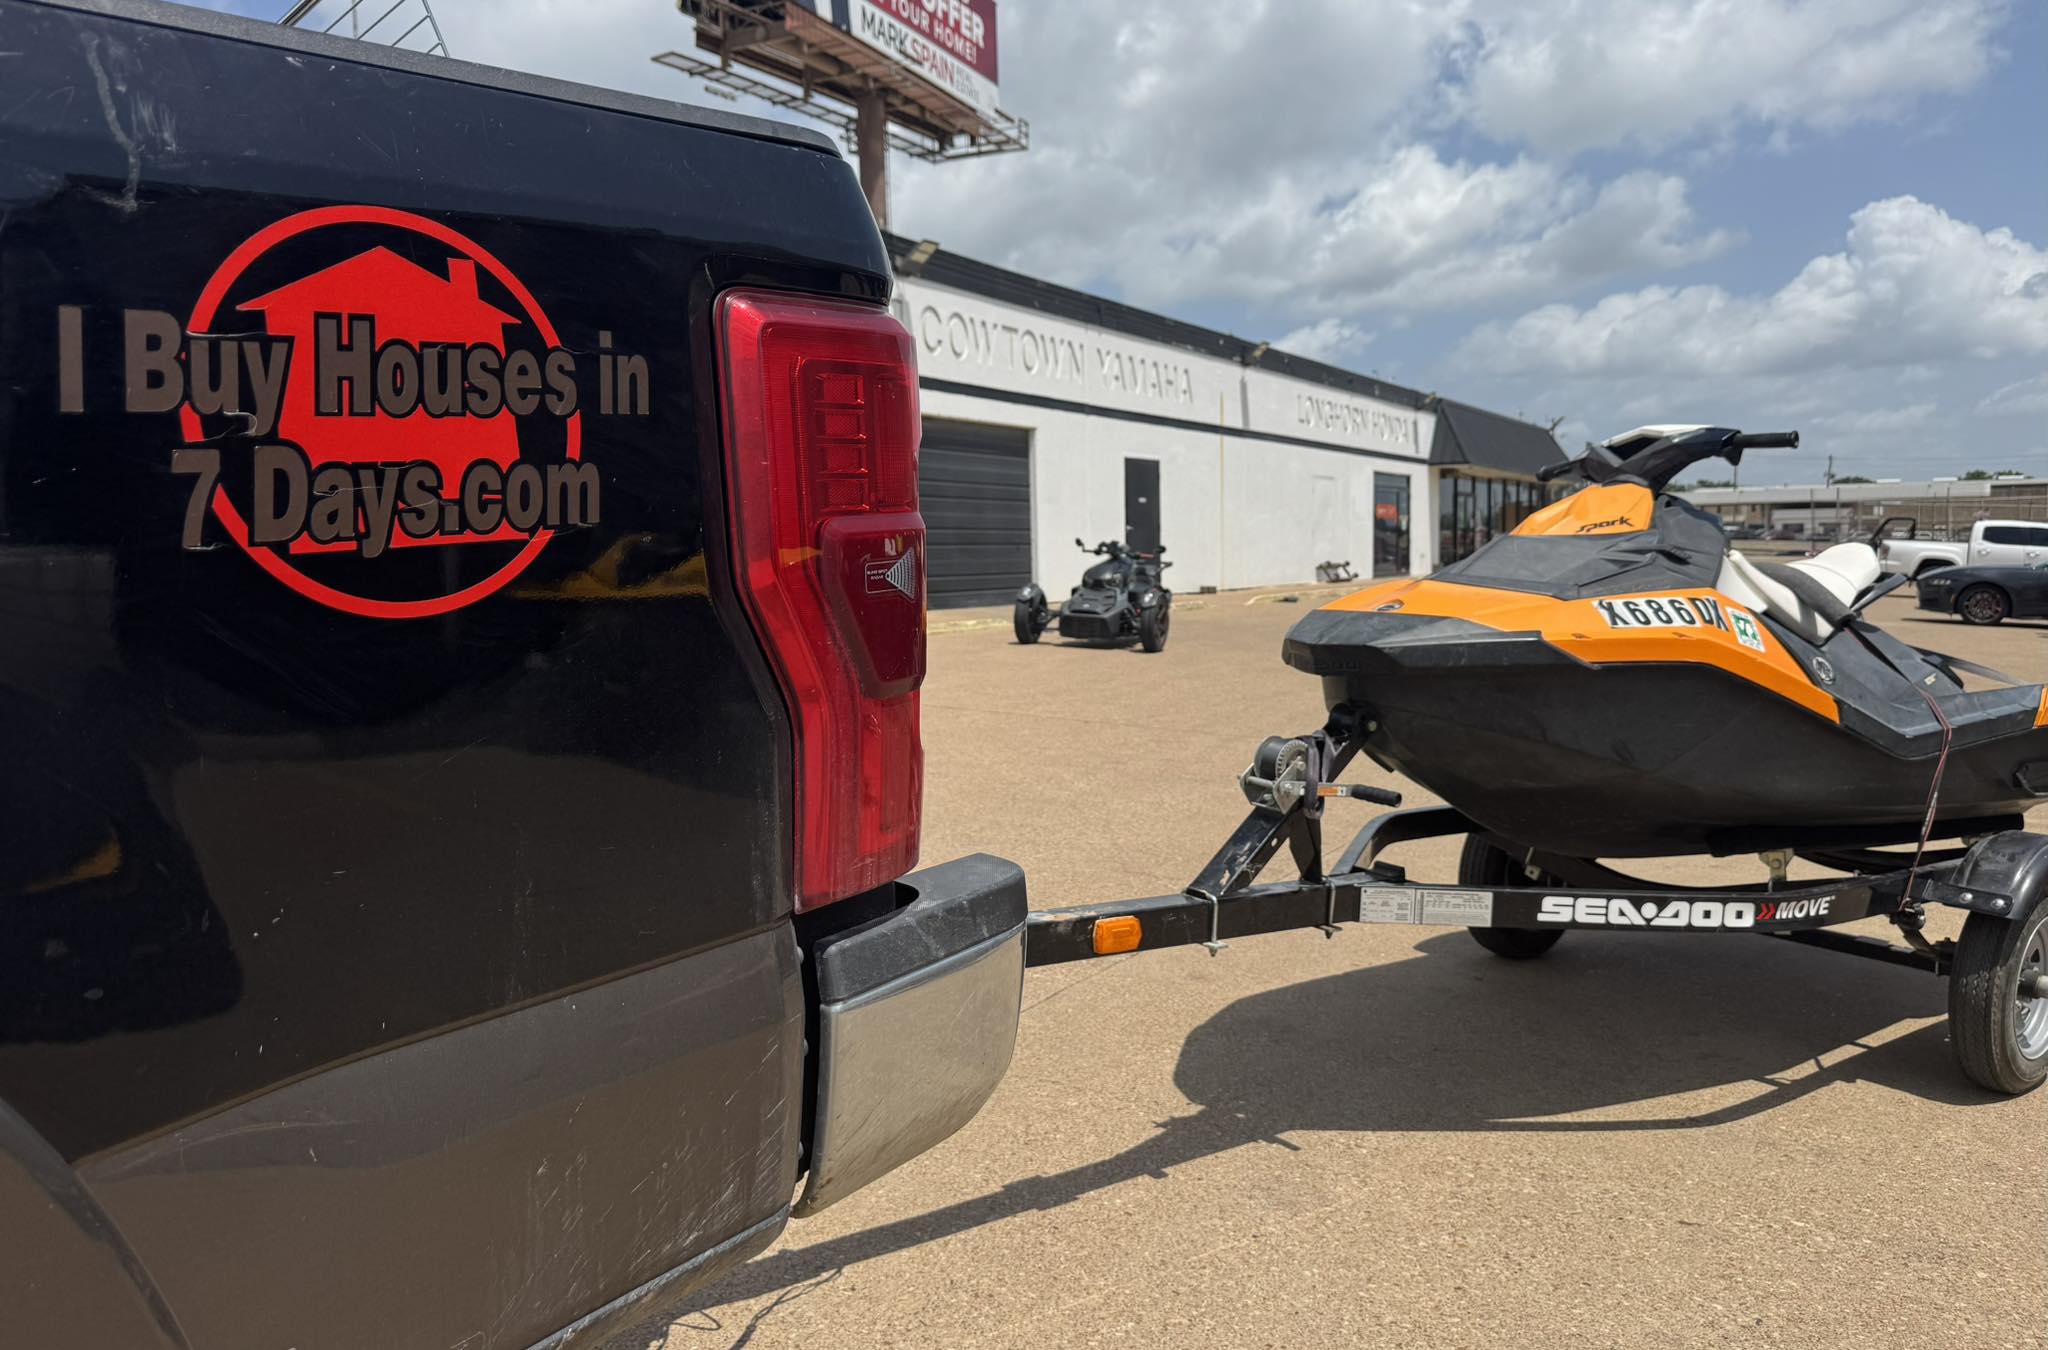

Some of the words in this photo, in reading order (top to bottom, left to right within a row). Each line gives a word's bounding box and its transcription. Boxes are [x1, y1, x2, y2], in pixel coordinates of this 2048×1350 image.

[861, 5, 909, 51] MARK
[911, 37, 955, 87] SPAIN
[933, 20, 977, 64] HOME!
[58, 305, 84, 413] I
[124, 309, 290, 436] Buy
[315, 316, 579, 417] Houses
[600, 330, 651, 415] in
[920, 305, 1083, 384] COWTOWN
[1096, 347, 1194, 404] YAMAHA
[1297, 394, 1368, 434] LONGHORN
[1371, 410, 1409, 442] HONDA
[171, 450, 221, 549] 7
[252, 446, 600, 558] Days.com
